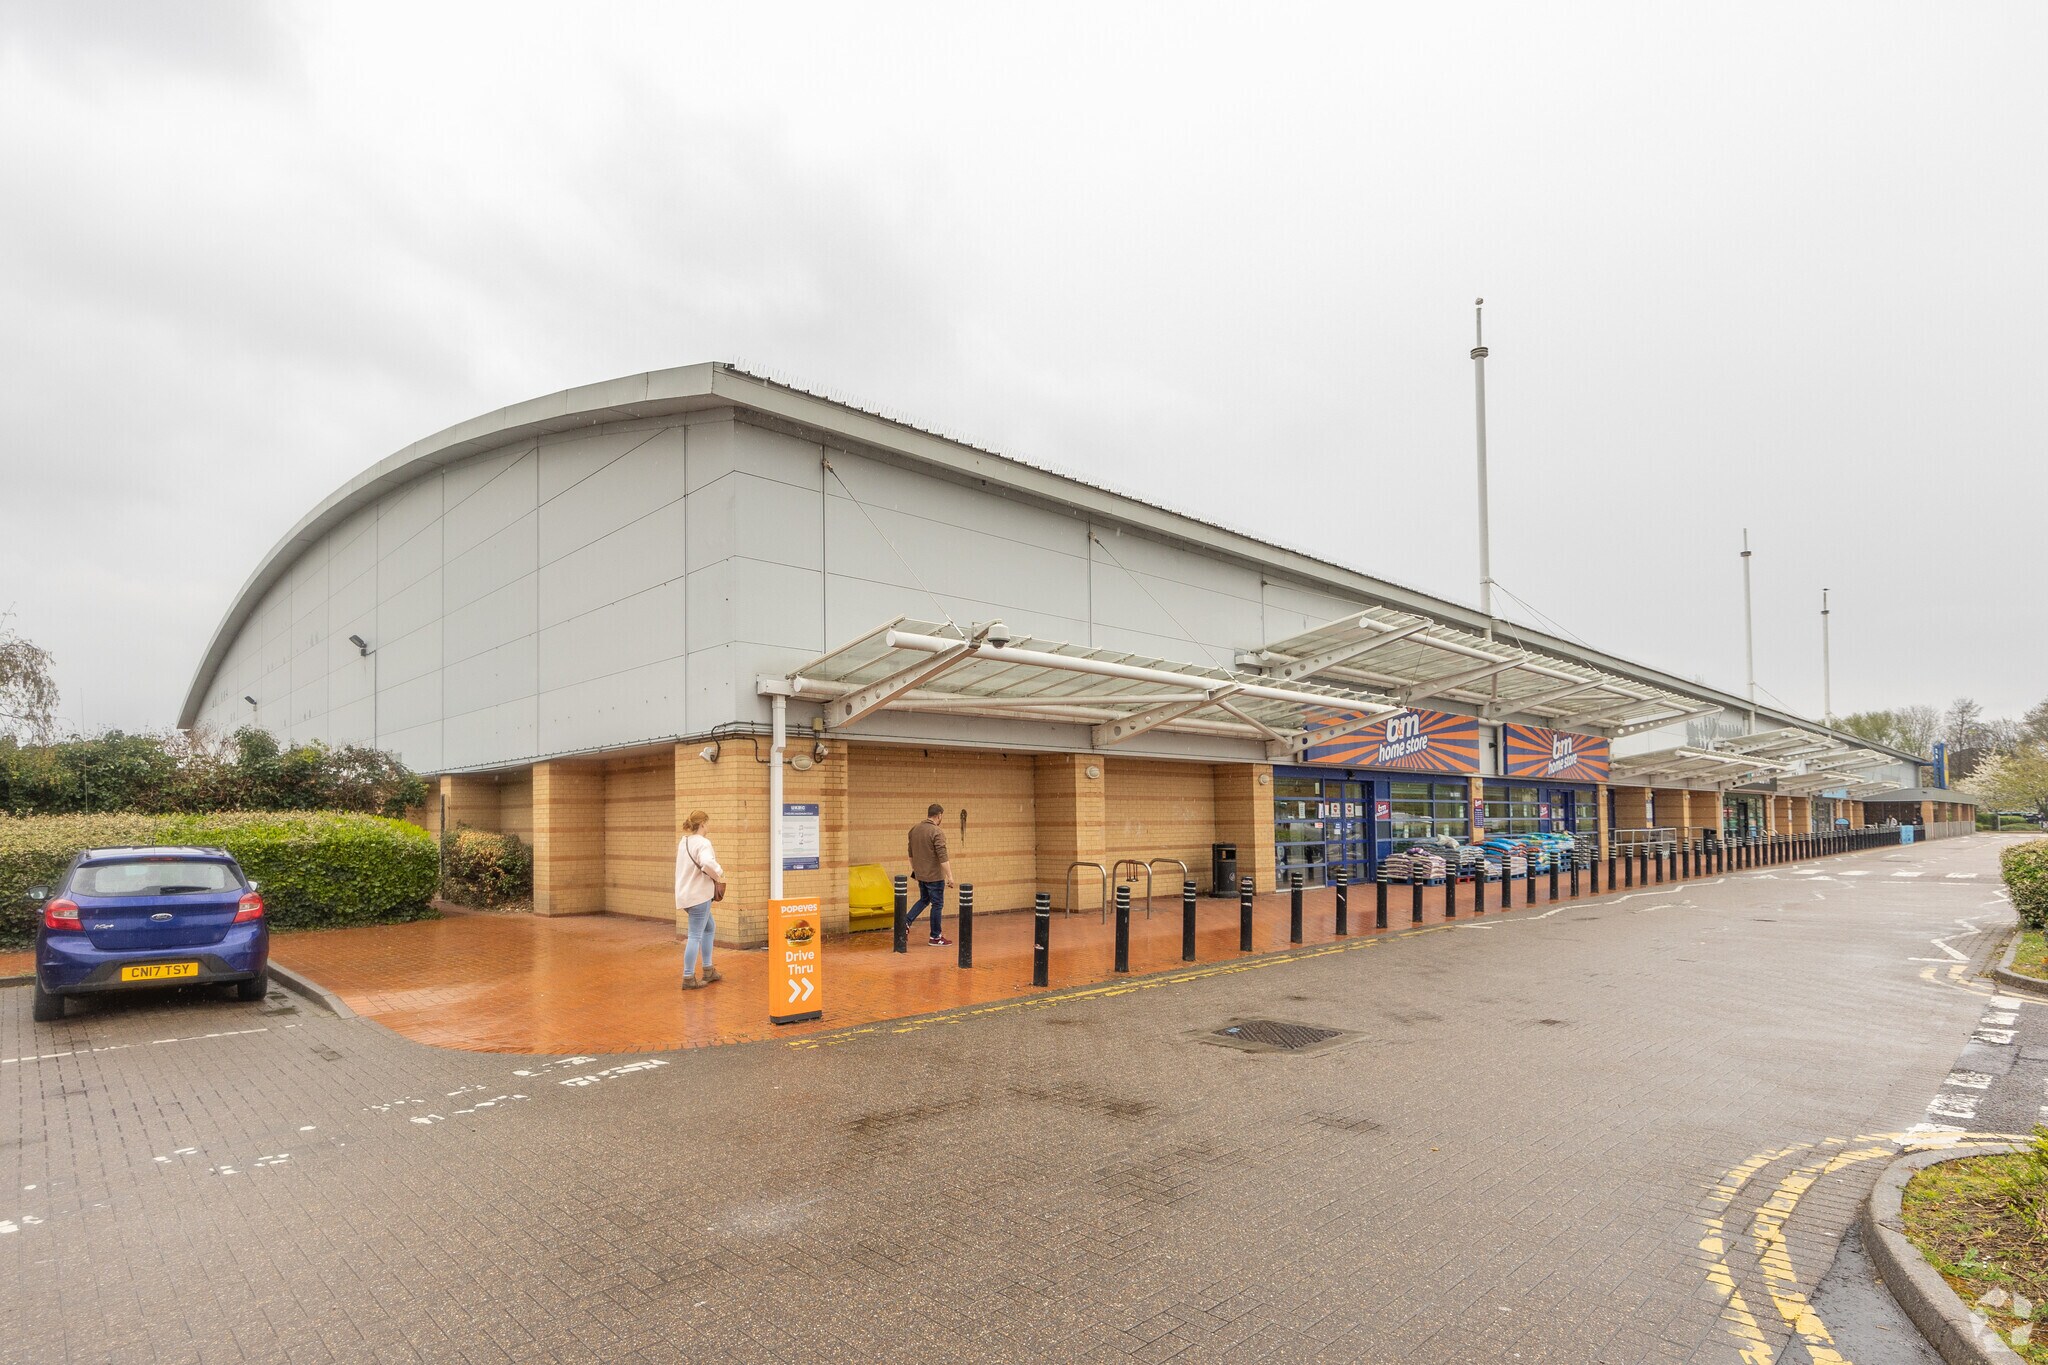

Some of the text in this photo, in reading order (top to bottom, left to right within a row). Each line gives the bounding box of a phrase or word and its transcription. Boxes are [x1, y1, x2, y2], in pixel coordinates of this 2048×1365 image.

[1379, 735, 1428, 762] home store
[785, 950, 814, 962] Drive
[131, 964, 190, 978] CN17 TSY
[788, 964, 814, 975] Thru
